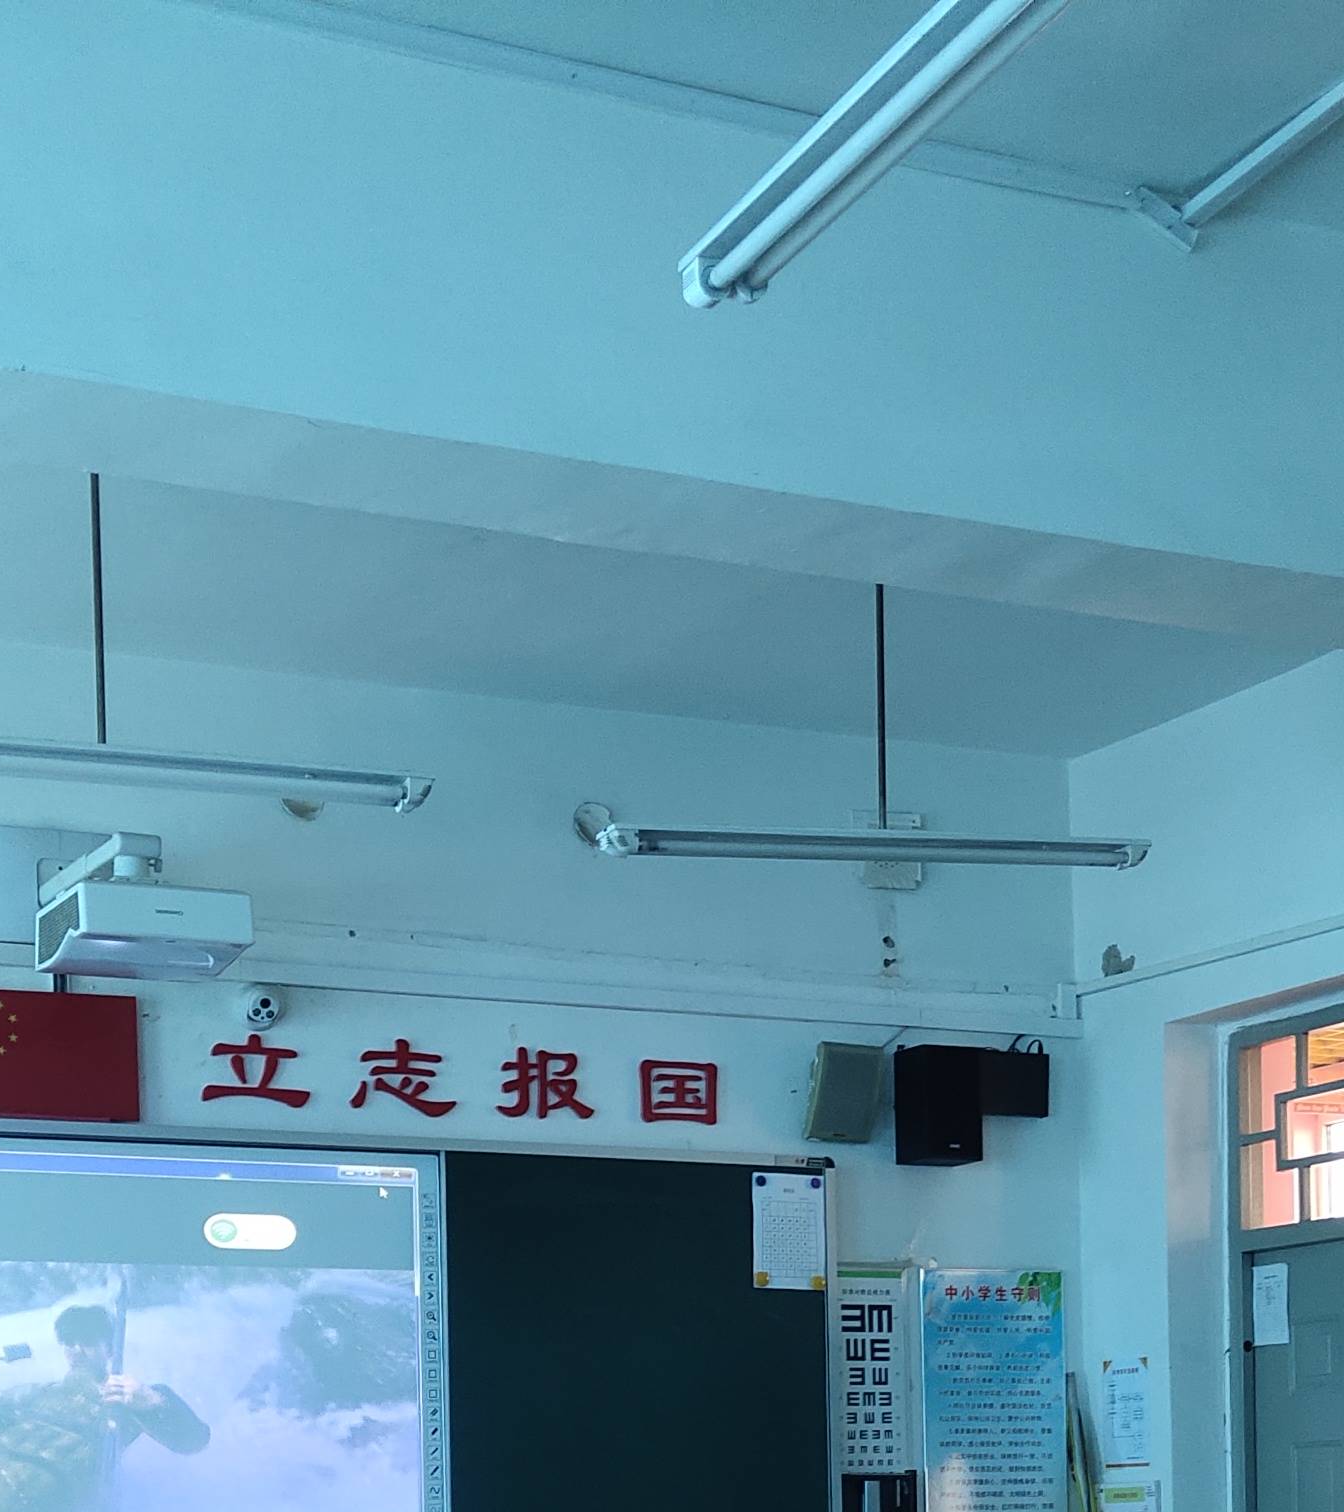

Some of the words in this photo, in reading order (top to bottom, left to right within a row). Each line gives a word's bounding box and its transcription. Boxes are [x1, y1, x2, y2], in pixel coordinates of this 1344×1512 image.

[202, 1034, 719, 1125] 立志报国
[944, 1285, 1042, 1303] 中小学生守则
